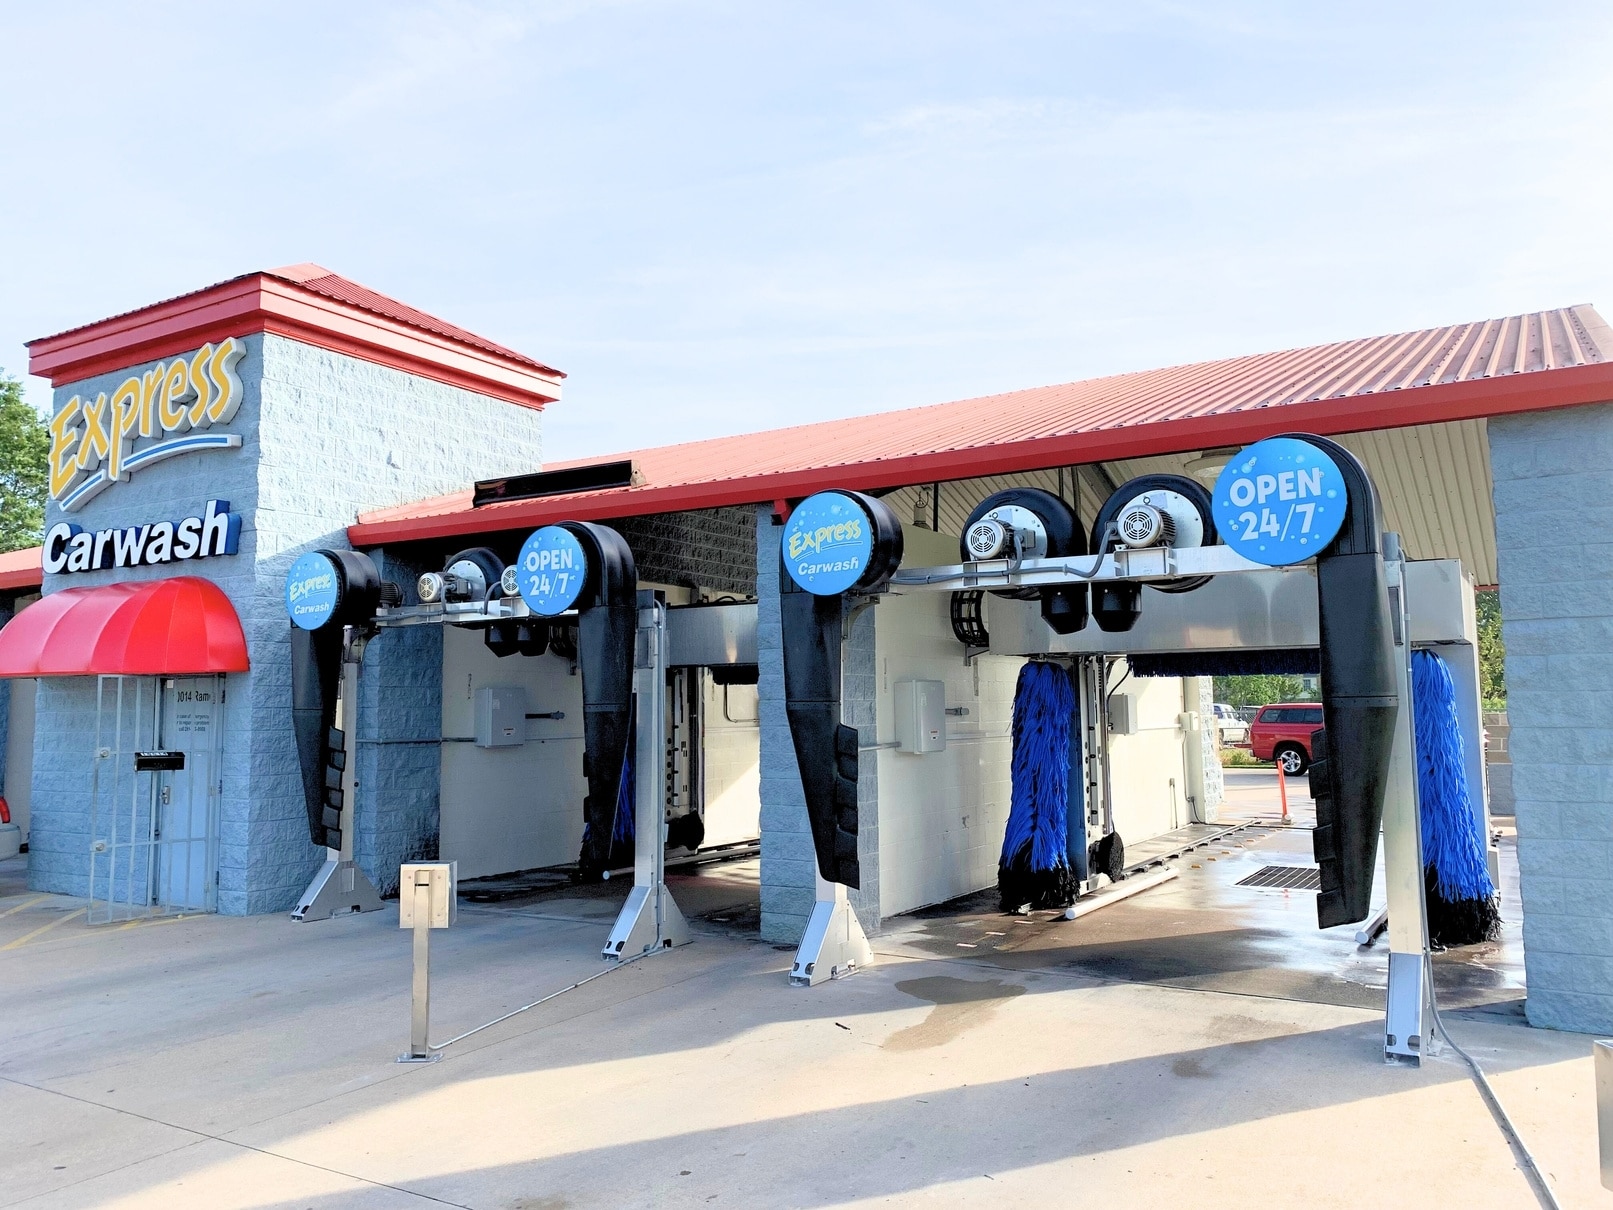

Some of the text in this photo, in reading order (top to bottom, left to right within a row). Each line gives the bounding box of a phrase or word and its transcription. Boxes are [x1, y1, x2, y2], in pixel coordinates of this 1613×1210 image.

[48, 337, 243, 499] Express
[1229, 467, 1322, 507] OPEN
[42, 499, 238, 574] Carwash
[789, 519, 861, 559] Express
[1238, 502, 1316, 542] 24/7
[526, 548, 573, 572] OPEN
[798, 556, 859, 576] Carwash
[289, 573, 331, 603] Express
[529, 571, 569, 599] 24/7
[294, 601, 330, 615] Carwash
